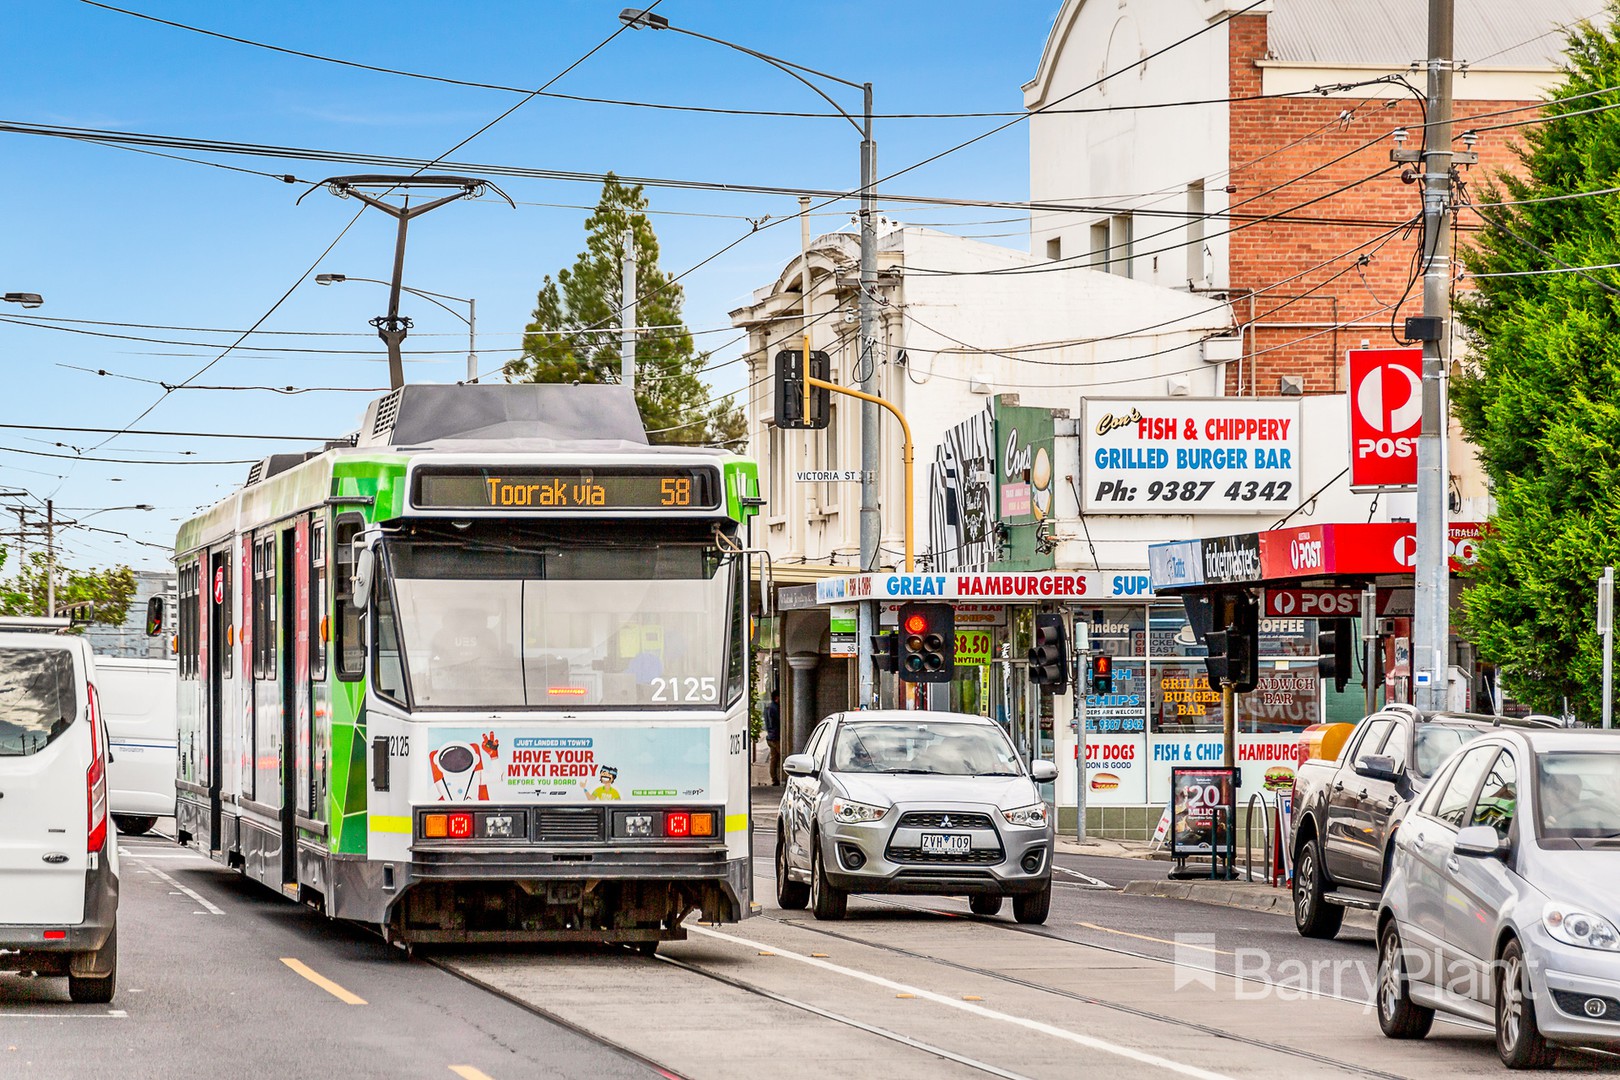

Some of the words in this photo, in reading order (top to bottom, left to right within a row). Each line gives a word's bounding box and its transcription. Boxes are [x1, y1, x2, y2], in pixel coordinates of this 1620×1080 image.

[1095, 406, 1142, 436] Con's
[1138, 417, 1177, 441] FISH
[1183, 417, 1199, 441] &
[1205, 418, 1291, 441] CHIPPERY
[1095, 447, 1169, 470] GRILLED
[1176, 447, 1248, 470] BURGER
[1254, 447, 1292, 470] BAR
[796, 471, 840, 480] VICTORIA
[844, 471, 856, 480] ST
[487, 478, 567, 506] Toorak
[573, 478, 605, 506] via
[661, 478, 690, 506] 58
[1095, 479, 1137, 502] Ph:
[1147, 480, 1216, 502] 9387
[1224, 480, 1293, 502] 4342
[1448, 528, 1480, 537] TRALIA
[1205, 543, 1256, 578] ticketmaster
[1299, 541, 1322, 568] POST
[886, 575, 946, 596] GREAT
[957, 575, 1087, 596] HAMBURGERS
[953, 604, 978, 612] RGER
[1088, 619, 1130, 634] inders
[650, 677, 717, 702] 2125
[1160, 678, 1210, 690] GRILLE
[1257, 677, 1316, 690] NDWICH
[1086, 694, 1140, 706] CHIPS
[1163, 691, 1222, 703] BURGER
[1263, 692, 1294, 706] BAR
[1176, 704, 1207, 716] BAR
[1086, 719, 1097, 730] EL.
[1099, 718, 1121, 730] 9387
[1122, 718, 1144, 730] 4342
[390, 735, 410, 757] 2125
[516, 739, 533, 747] JUST
[534, 739, 559, 747] LANDED
[560, 739, 567, 747] IN
[568, 739, 591, 747] TOWN?
[512, 750, 552, 763] HAVE
[555, 750, 594, 763] YOUR
[1103, 744, 1135, 760] DOGS
[1153, 743, 1180, 761] FISH
[1183, 743, 1192, 761] &
[1196, 743, 1224, 761] CHIP
[1238, 743, 1298, 761] HAMBURG
[507, 764, 546, 777] MYKI
[549, 764, 599, 777] READY
[1102, 761, 1109, 769] IS
[1111, 761, 1132, 769] GOOD
[923, 836, 943, 848] ZVH
[951, 837, 969, 848] 109
